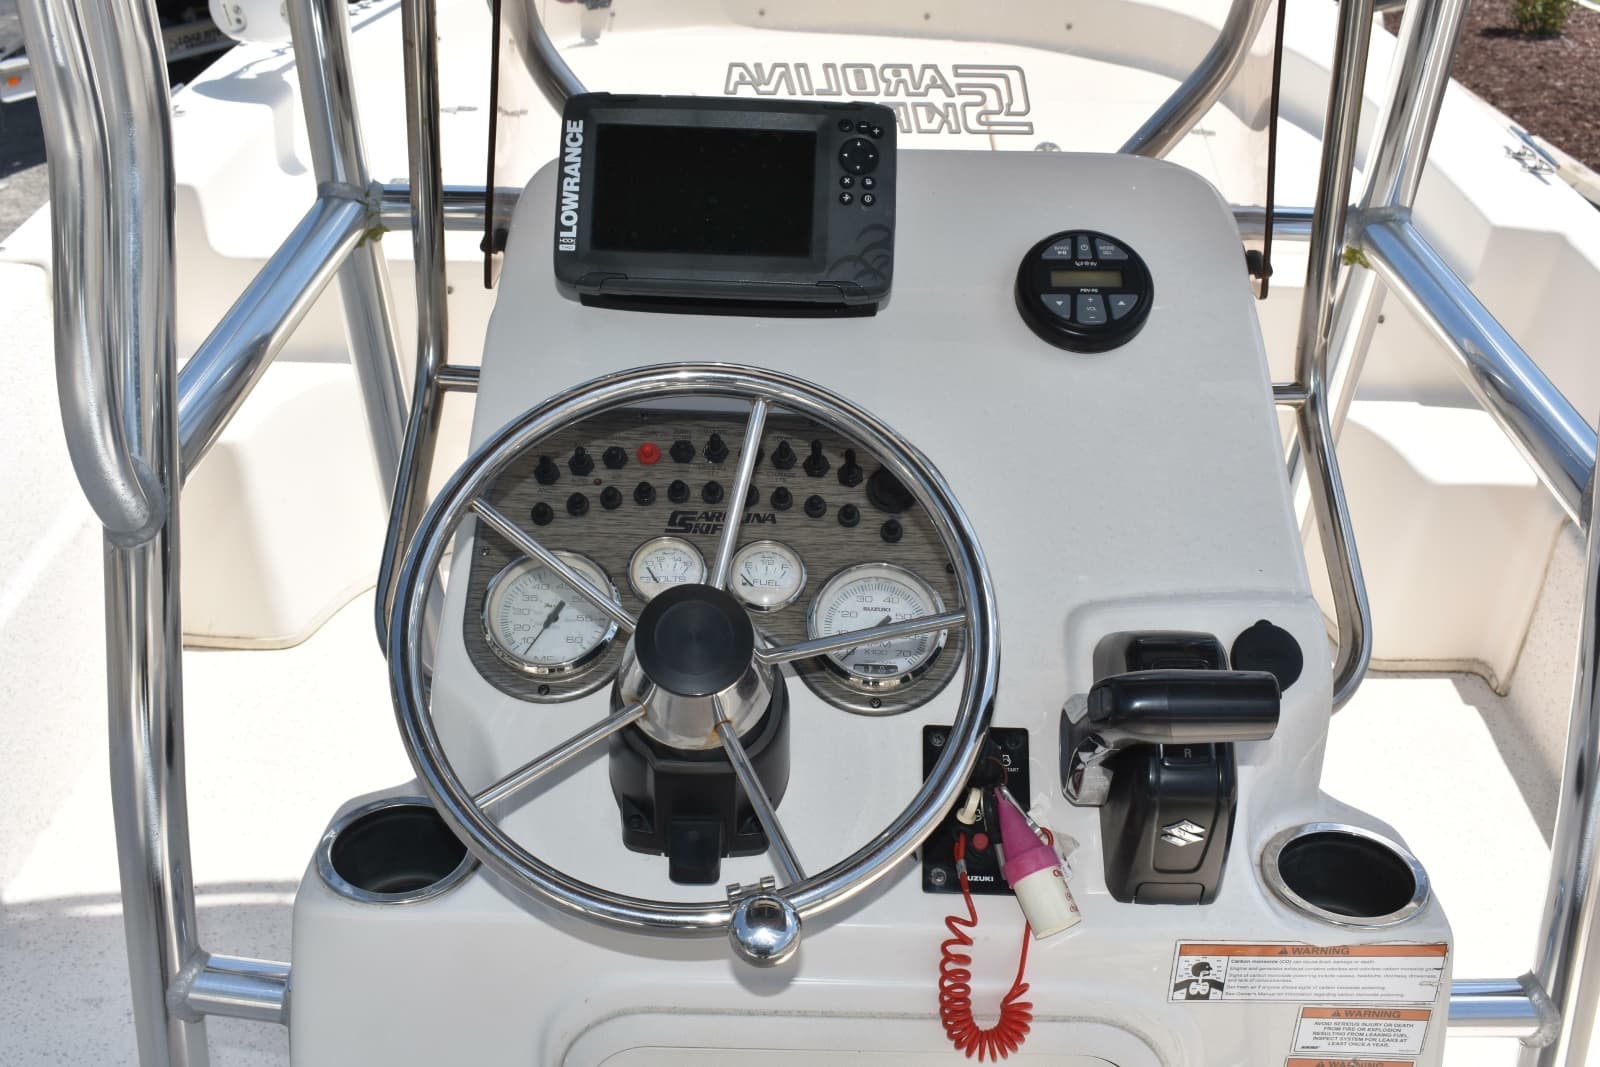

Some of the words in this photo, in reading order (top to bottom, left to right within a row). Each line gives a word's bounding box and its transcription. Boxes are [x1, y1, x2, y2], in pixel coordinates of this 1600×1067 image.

[560, 119, 584, 238] LOWRANCE
[752, 579, 781, 587] FUEL
[856, 595, 873, 603] 30
[883, 596, 900, 604] 40
[841, 610, 858, 618] 20
[895, 649, 912, 657] 70
[1184, 748, 1192, 758] R
[1291, 946, 1351, 955] WARNING
[1344, 1009, 1401, 1019] WARNING
